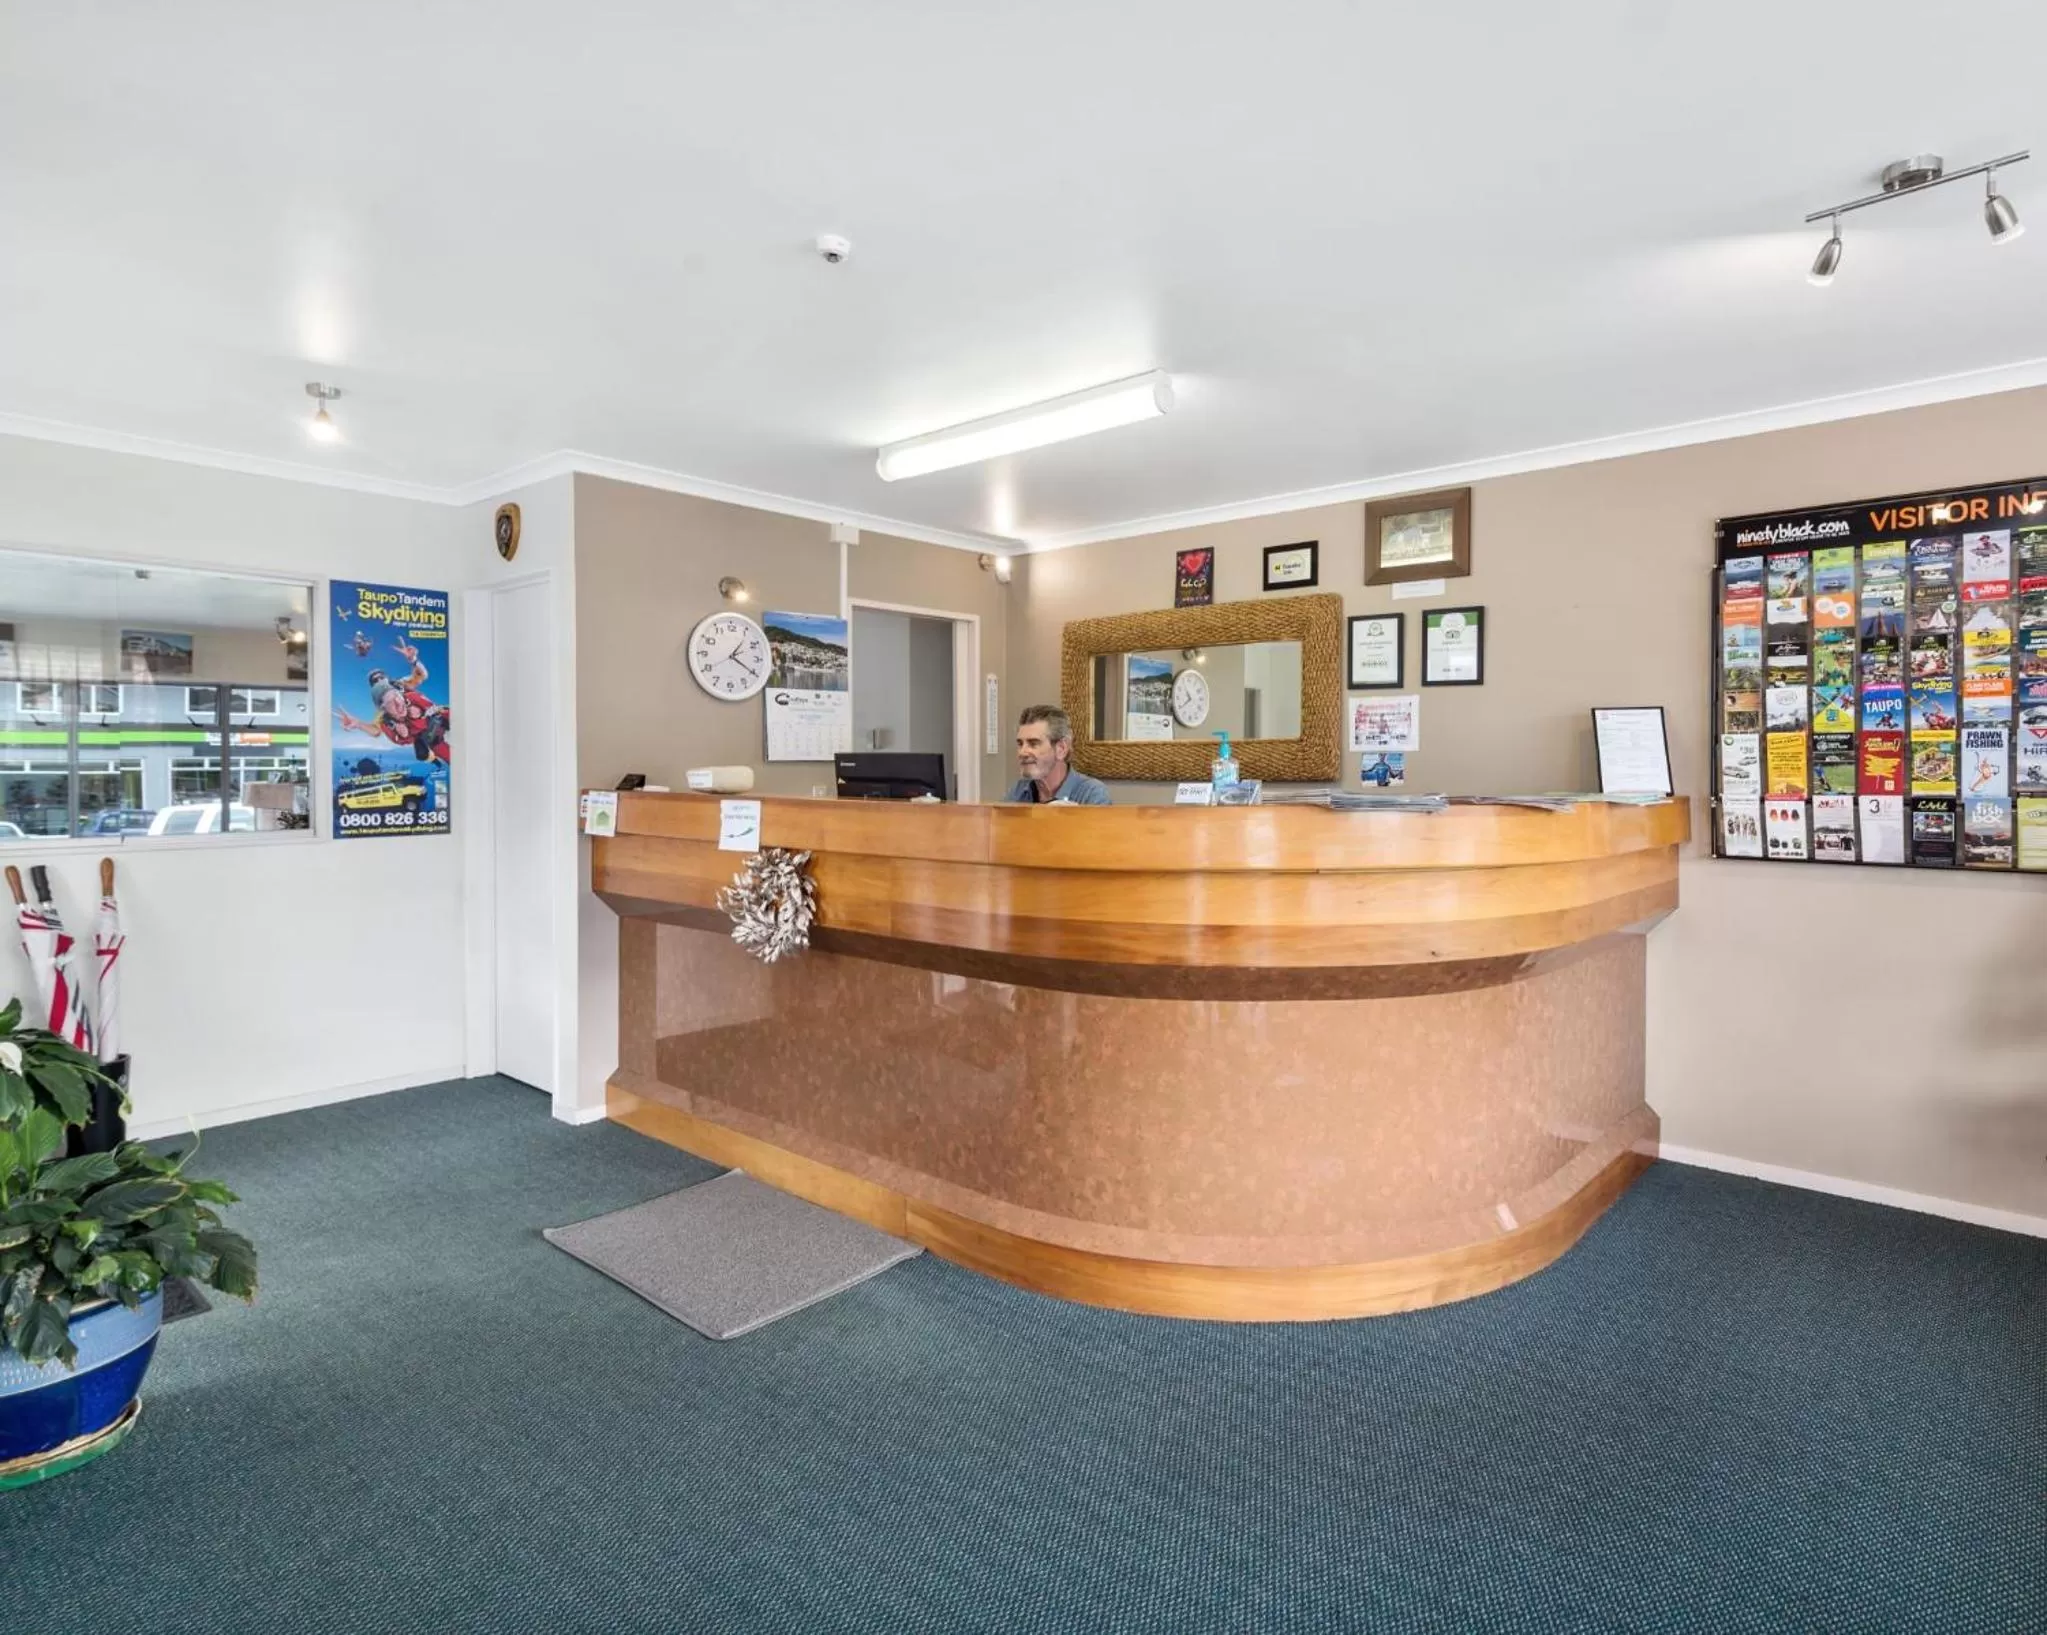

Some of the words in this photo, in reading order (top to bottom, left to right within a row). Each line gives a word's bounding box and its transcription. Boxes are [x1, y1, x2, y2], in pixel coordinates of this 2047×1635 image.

[1870, 498, 1989, 532] VISITOR
[1737, 520, 1850, 544] ninetyblack.com
[358, 601, 445, 628] Skydiving
[1864, 699, 1902, 713] TAUPO
[1967, 731, 2002, 740] PRAWN
[1966, 740, 2003, 749] FISHING
[340, 813, 381, 827] 0800
[385, 812, 414, 825] 826
[418, 811, 448, 824] 336
